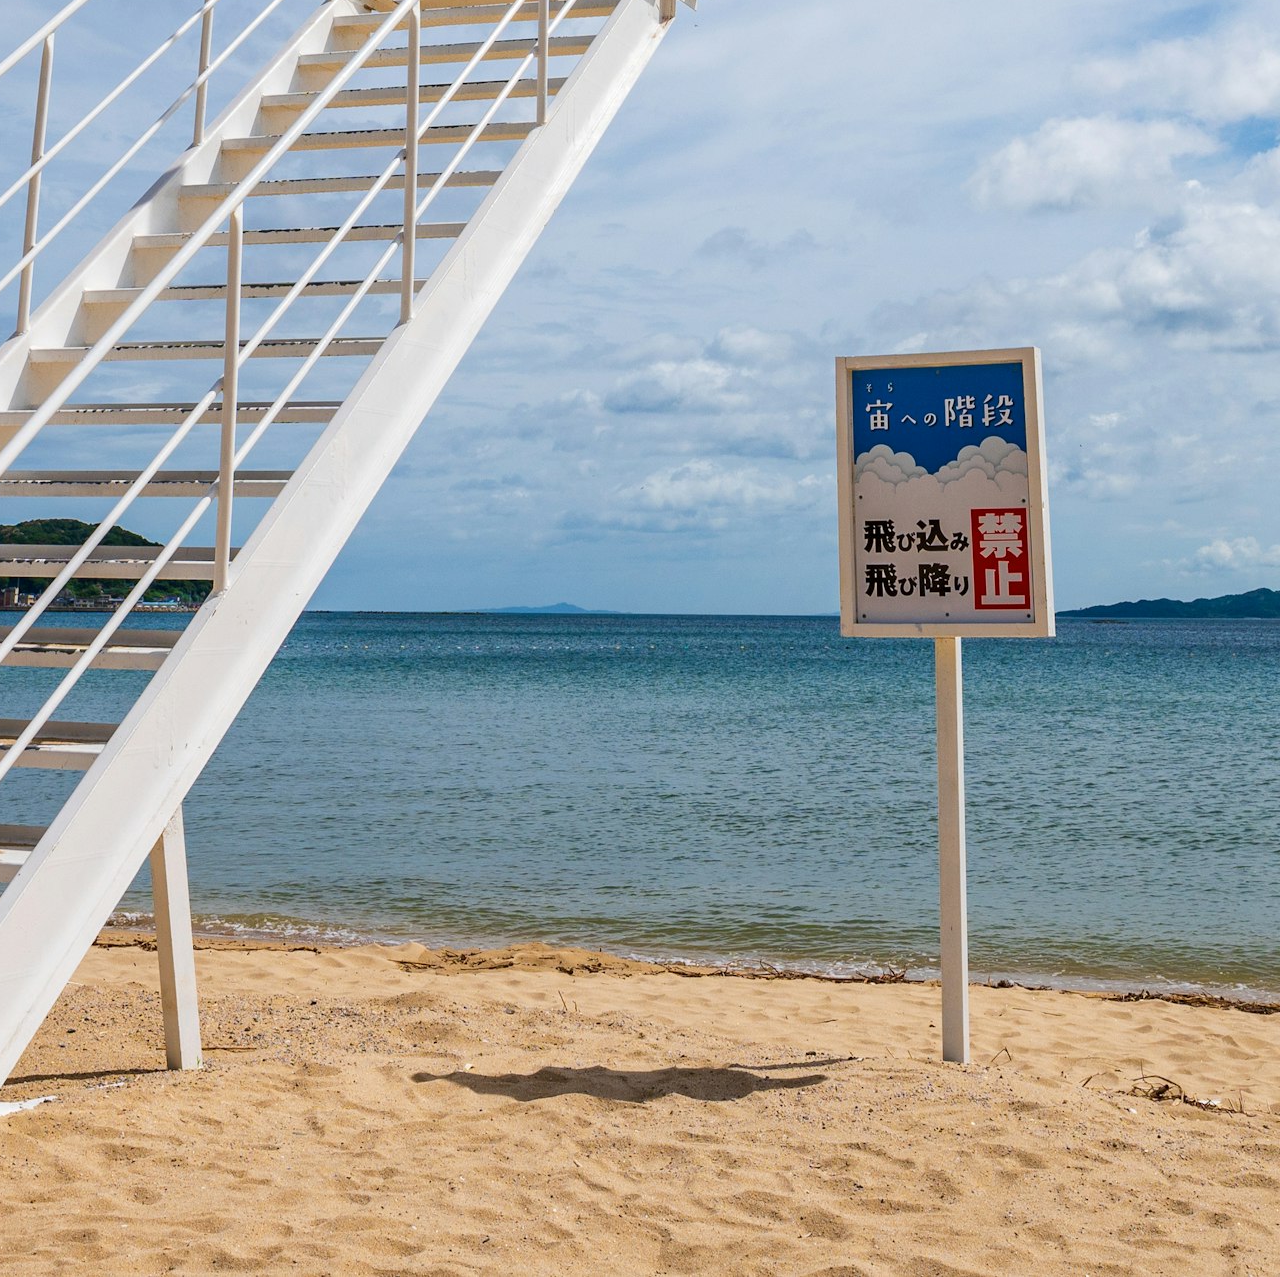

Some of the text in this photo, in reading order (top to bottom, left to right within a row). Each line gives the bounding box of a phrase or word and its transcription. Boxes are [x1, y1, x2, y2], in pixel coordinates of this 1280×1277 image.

[865, 393, 1014, 431] 宙への階段
[863, 519, 970, 554] 飛び込み
[977, 512, 1026, 606] 禁止
[864, 563, 970, 598] 飛び降り
